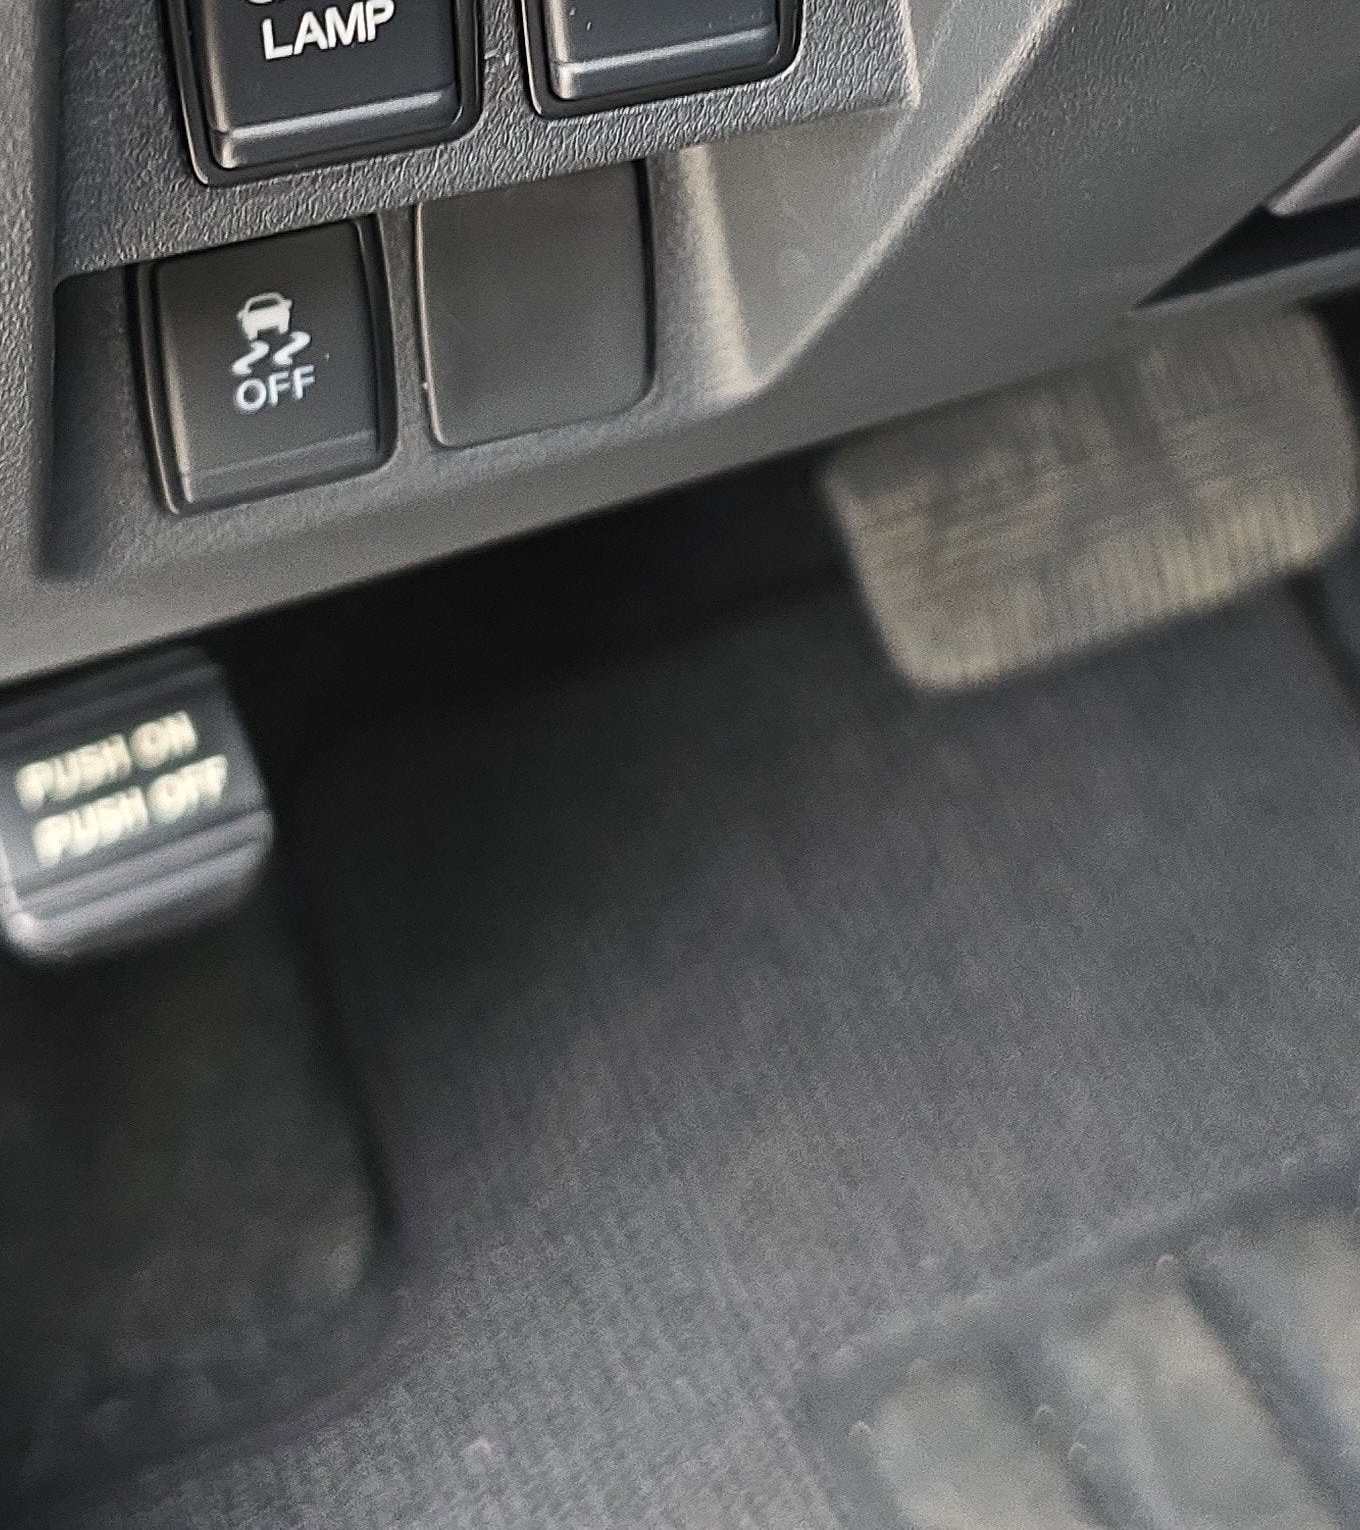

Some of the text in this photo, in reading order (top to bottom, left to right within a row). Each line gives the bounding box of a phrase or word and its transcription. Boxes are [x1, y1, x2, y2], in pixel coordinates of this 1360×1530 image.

[234, 364, 316, 413] OFF
[16, 710, 197, 810] PUSH ON
[34, 754, 228, 865] PUSH OFF
